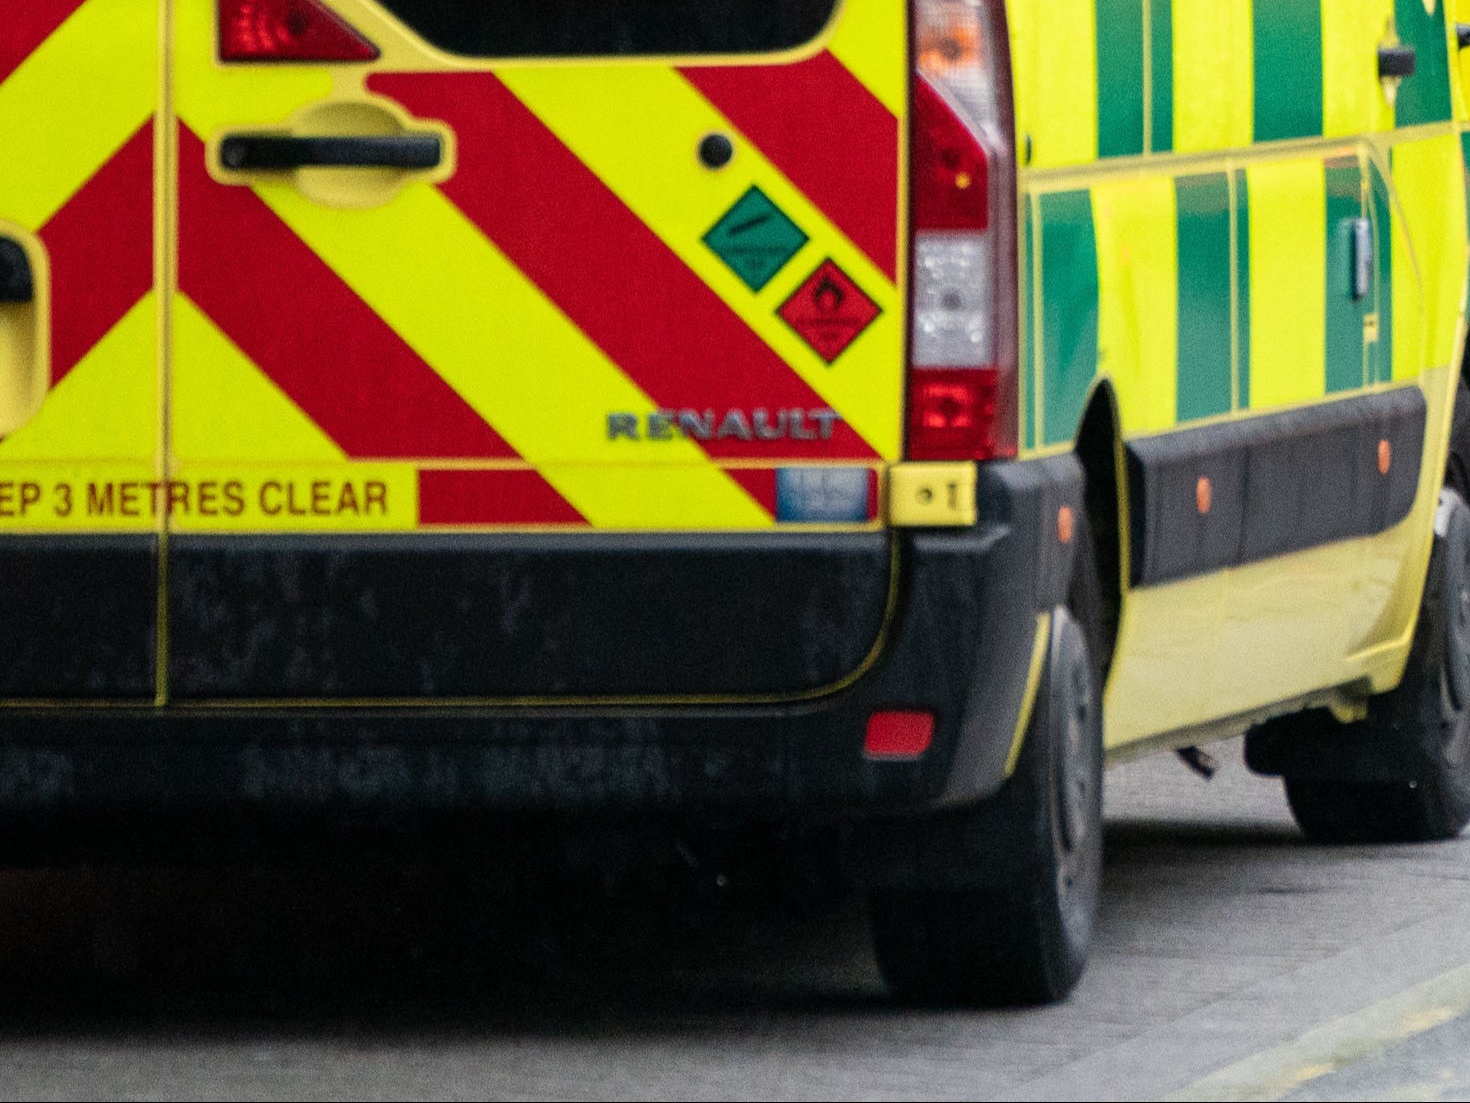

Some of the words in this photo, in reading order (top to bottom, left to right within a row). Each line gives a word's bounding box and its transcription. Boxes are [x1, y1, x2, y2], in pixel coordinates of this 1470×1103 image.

[606, 408, 845, 441] RENAULT
[53, 482, 73, 517] 3
[87, 481, 245, 516] METRES
[259, 481, 388, 516] CLEAR
